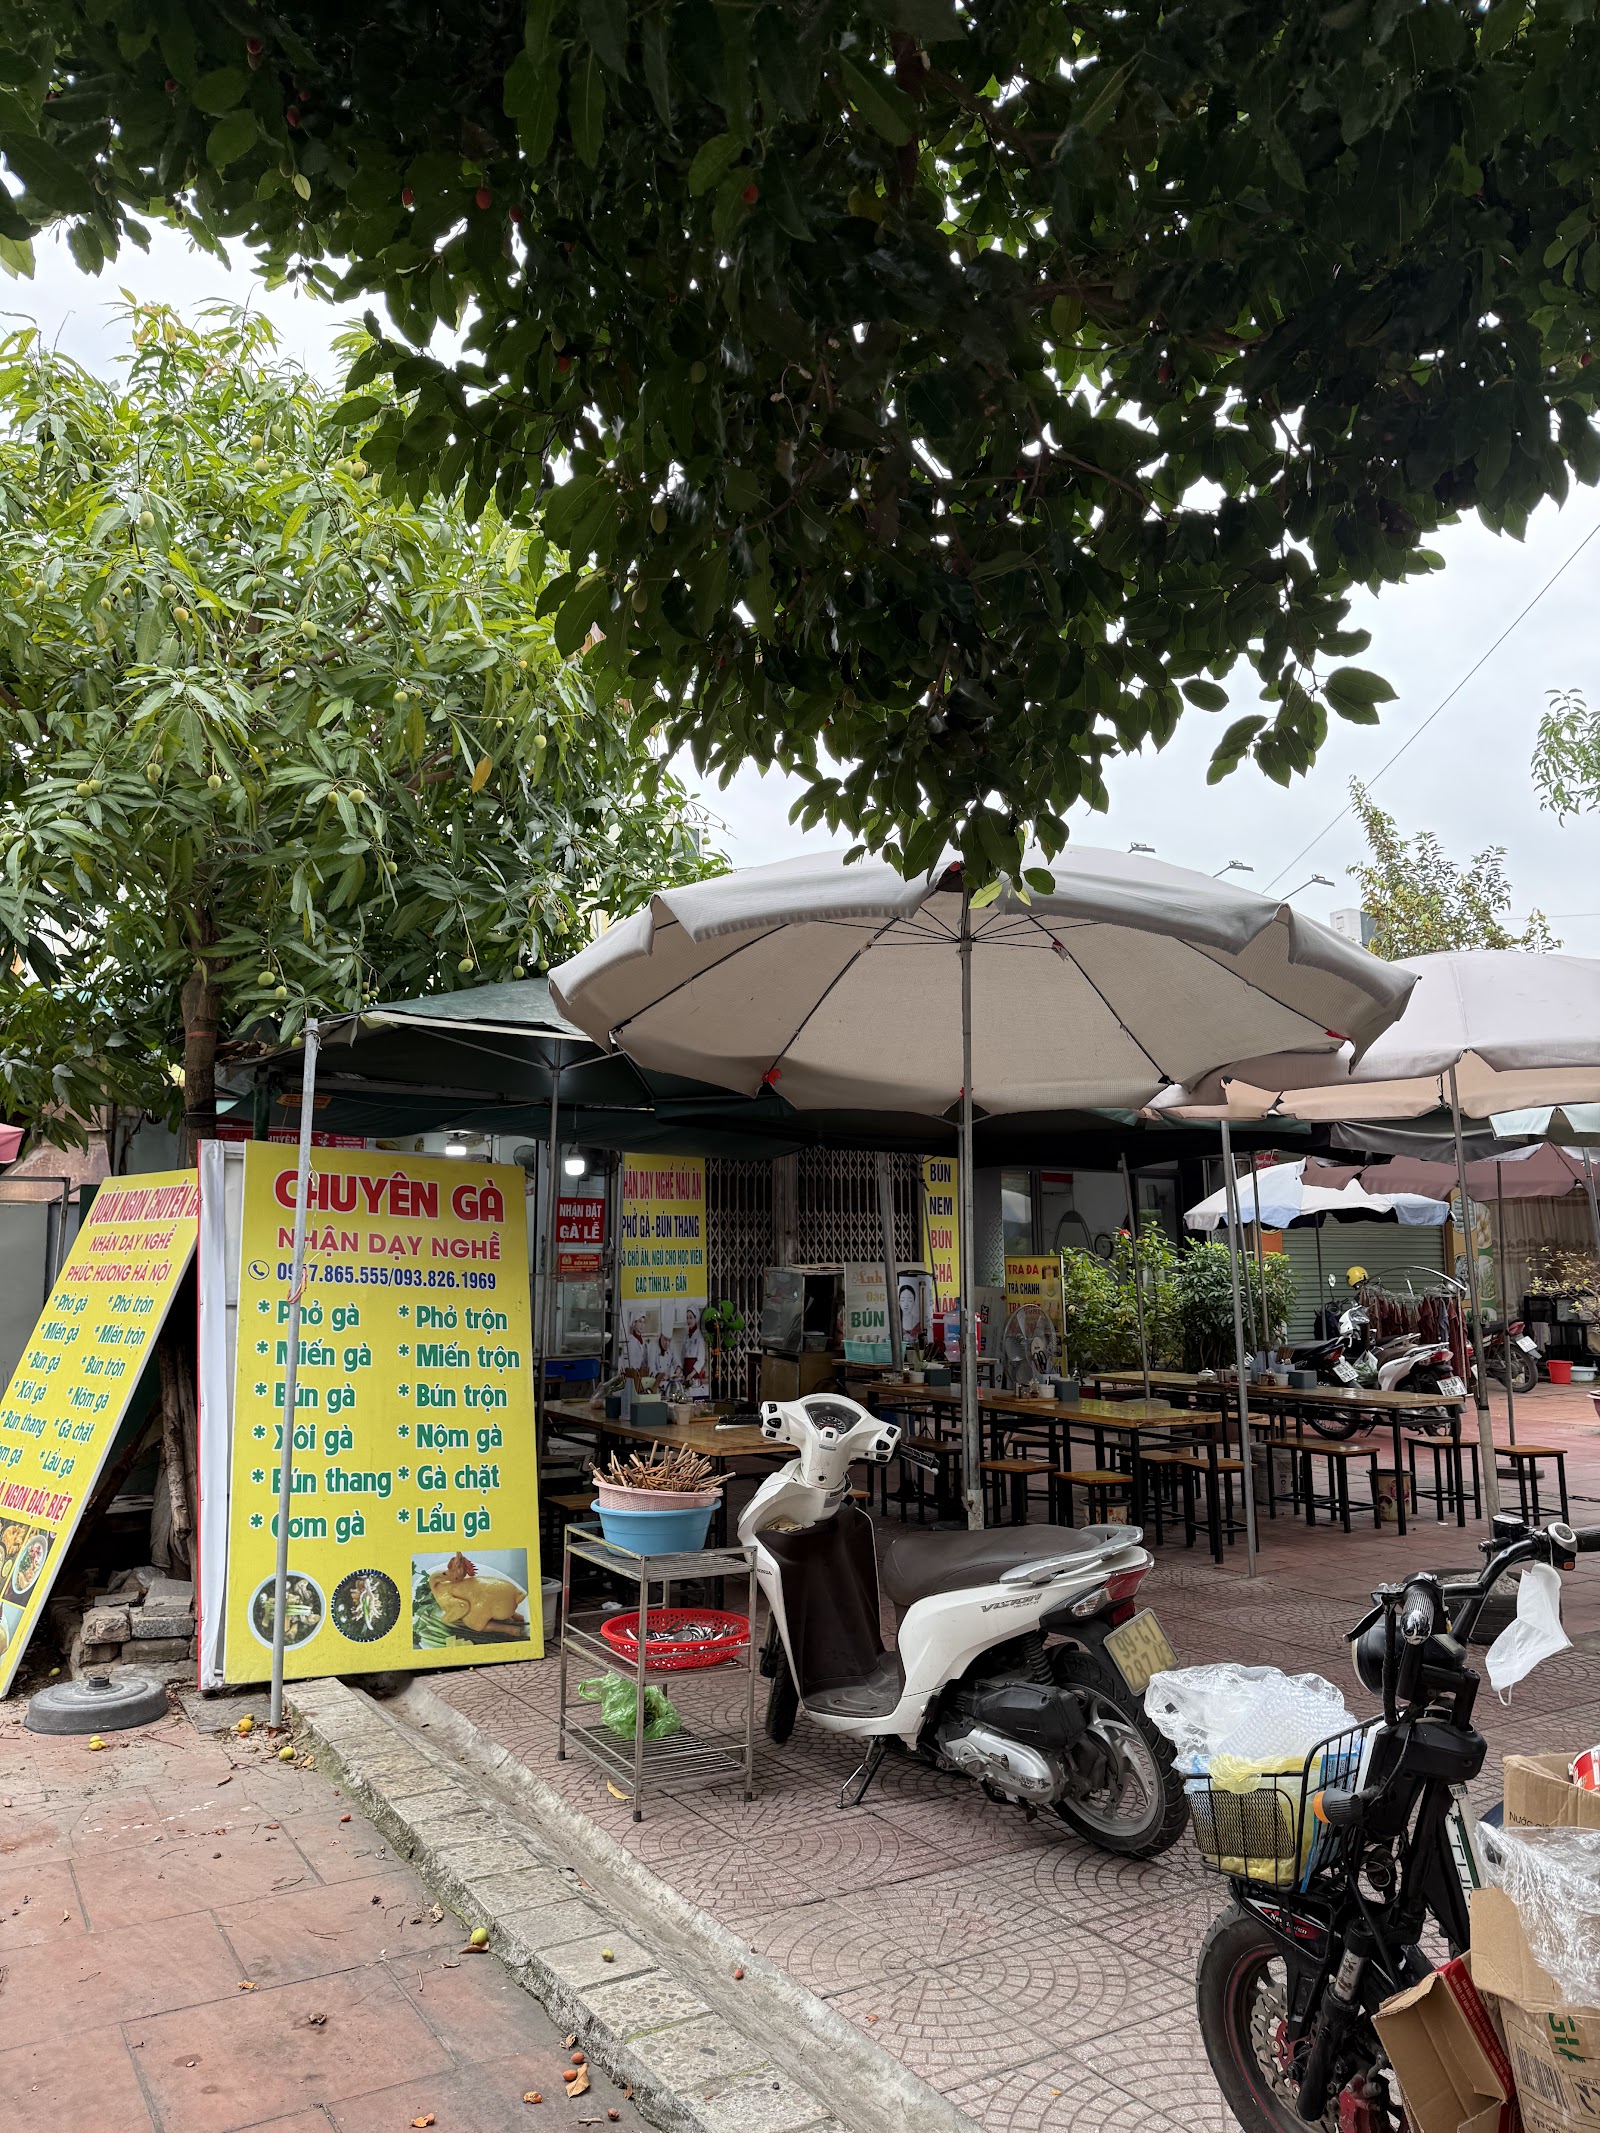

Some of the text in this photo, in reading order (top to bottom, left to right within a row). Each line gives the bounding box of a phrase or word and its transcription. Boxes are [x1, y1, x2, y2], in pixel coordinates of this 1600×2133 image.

[623, 1165, 638, 1205] HẬN
[930, 1160, 951, 1183] BÚN
[89, 1186, 124, 1227] QUÁN
[115, 1190, 152, 1222] NGON
[143, 1179, 194, 1220] CHUYÊN
[274, 1170, 504, 1223] CHUYÊN GÀ
[929, 1196, 953, 1216] NEM
[559, 1202, 602, 1220] NHẬN ĐẶT
[640, 1211, 650, 1238] GÀ
[656, 1211, 672, 1238] BÚN
[674, 1215, 700, 1238] THANG
[89, 1224, 178, 1256] NHẬN DẠY NGHỀ
[278, 1225, 500, 1261] NHẬN DẠY NGHỀ
[931, 1226, 952, 1249] BÚN
[665, 1249, 676, 1265] CHO
[65, 1259, 172, 1287] PHÚC HƯƠNG HÀ NỘI
[662, 1277, 671, 1292] XA
[55, 1292, 89, 1315] Phở gà
[111, 1292, 155, 1317] Phở trộn
[332, 1303, 360, 1331] gà
[416, 1304, 507, 1335] Phở trộn
[851, 1308, 885, 1328] BÚN
[43, 1320, 80, 1345] Miến gà
[97, 1322, 146, 1349] Miến trộn
[29, 1351, 62, 1375] Bún gà
[84, 1355, 126, 1380] Bún trộn
[276, 1338, 372, 1372] Miến gà
[416, 1341, 520, 1374] Miến trộn
[16, 1380, 48, 1405] Xôi gà
[70, 1386, 110, 1413] Nộm gà
[275, 1382, 356, 1414] Bún gà
[416, 1383, 507, 1413] Bún trộn
[3, 1410, 47, 1439] Bún thang
[58, 1418, 95, 1446] Gà chặt
[324, 1425, 353, 1455] gà
[416, 1424, 503, 1454] Nộm gà
[7, 1445, 24, 1468] gà
[58, 1455, 75, 1479] gà
[272, 1467, 392, 1498] Bún thang
[417, 1465, 500, 1494] Gà chặt
[1, 1483, 32, 1511] NGON
[45, 1490, 72, 1526] BIỆT
[335, 1511, 365, 1543] gà
[416, 1503, 491, 1538] Lẩu gà
[980, 1592, 1043, 1613] VISION
